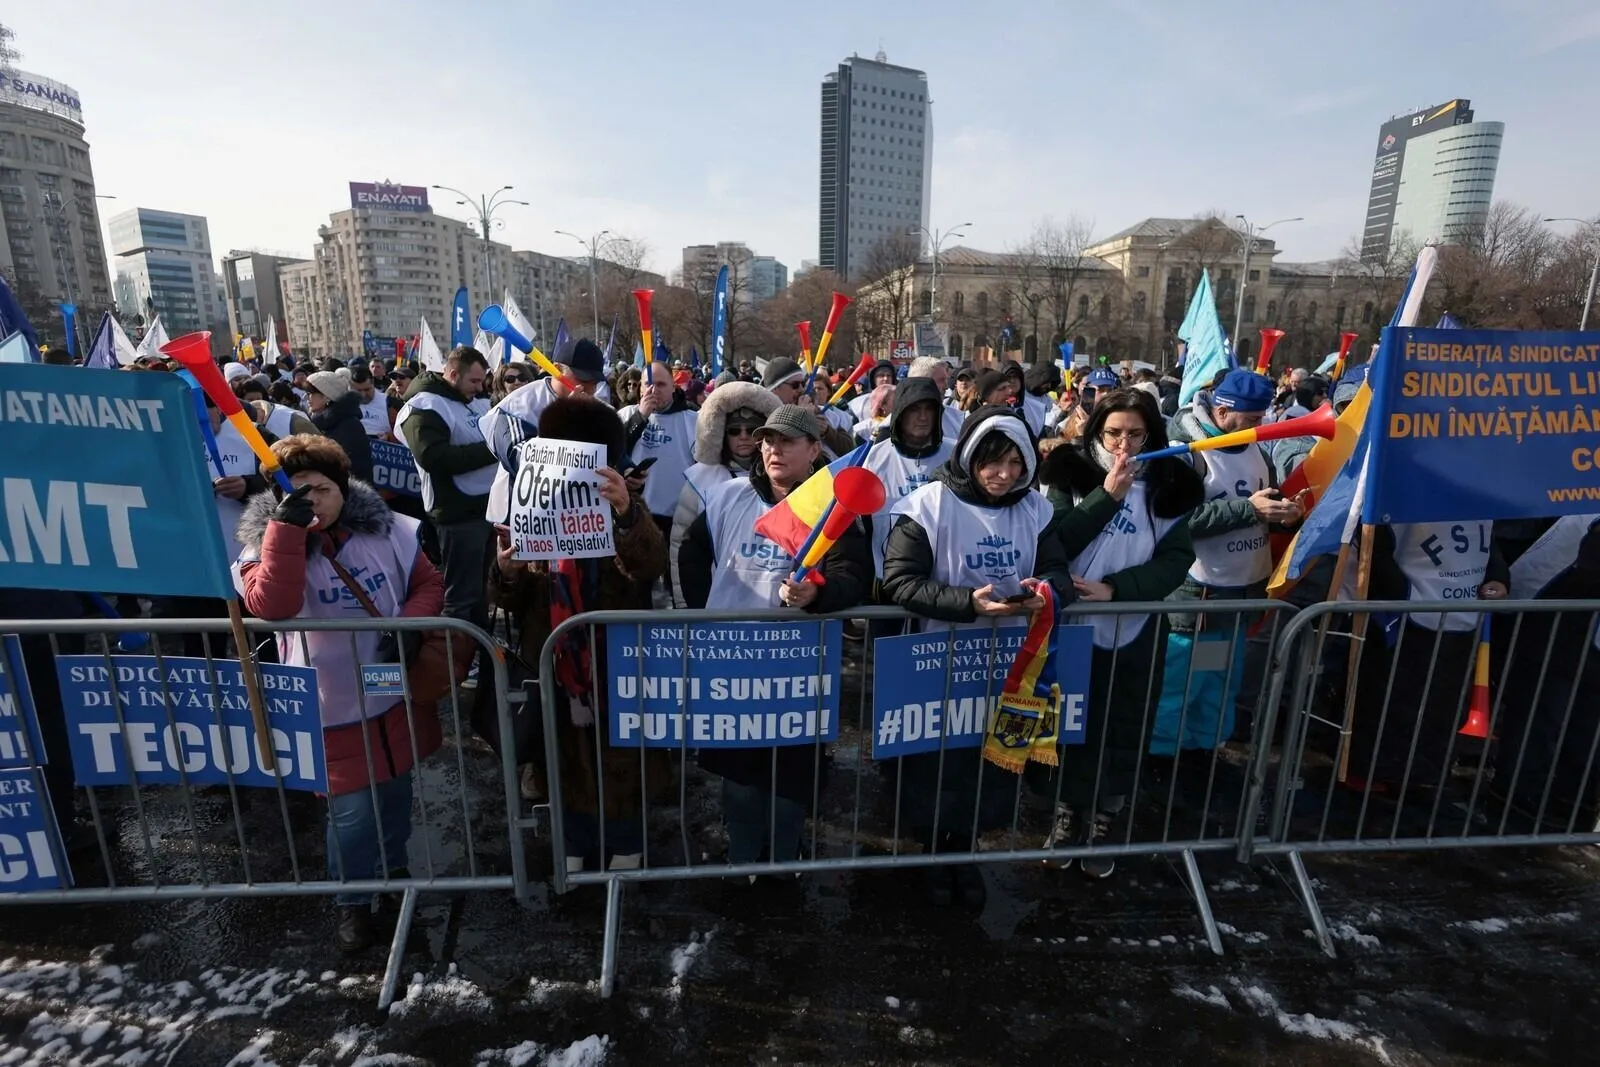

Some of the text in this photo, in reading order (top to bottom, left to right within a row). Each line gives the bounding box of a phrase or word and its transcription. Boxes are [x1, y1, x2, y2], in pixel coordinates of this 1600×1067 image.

[1412, 114, 1425, 126] EY
[357, 192, 422, 205] ENAYATI
[1405, 342, 1600, 368] FEDERAȚIA SINDICAT
[1402, 371, 1600, 397] SINDICATUL LI
[0, 390, 164, 432] ATAMANT
[1389, 413, 1440, 438] DIN
[524, 443, 598, 470] Căutăm Ministru!
[372, 464, 421, 493] CUC
[517, 463, 600, 510] Oferim:
[0, 478, 148, 570] MT
[514, 508, 606, 536] salarii tăiate
[525, 536, 554, 553] haos
[555, 533, 610, 556] legislativ!
[966, 549, 1021, 570] USLIP
[318, 572, 387, 605] USIP
[753, 628, 801, 642] LIBER
[911, 636, 1027, 656] SINDCATUL LI
[622, 645, 651, 658] DIN
[769, 645, 828, 660] TECUCI
[915, 651, 1016, 672] DIN NVĂȚĂM
[70, 666, 308, 693] SINDICATUL LBER
[364, 672, 401, 683] DGJMB
[617, 674, 832, 706] UNIȚI SUNTEM
[82, 686, 304, 715] DIN ÎNVĂȚĂMNT
[618, 709, 831, 741] PUTERNICI!
[78, 722, 317, 780] TECUCI
